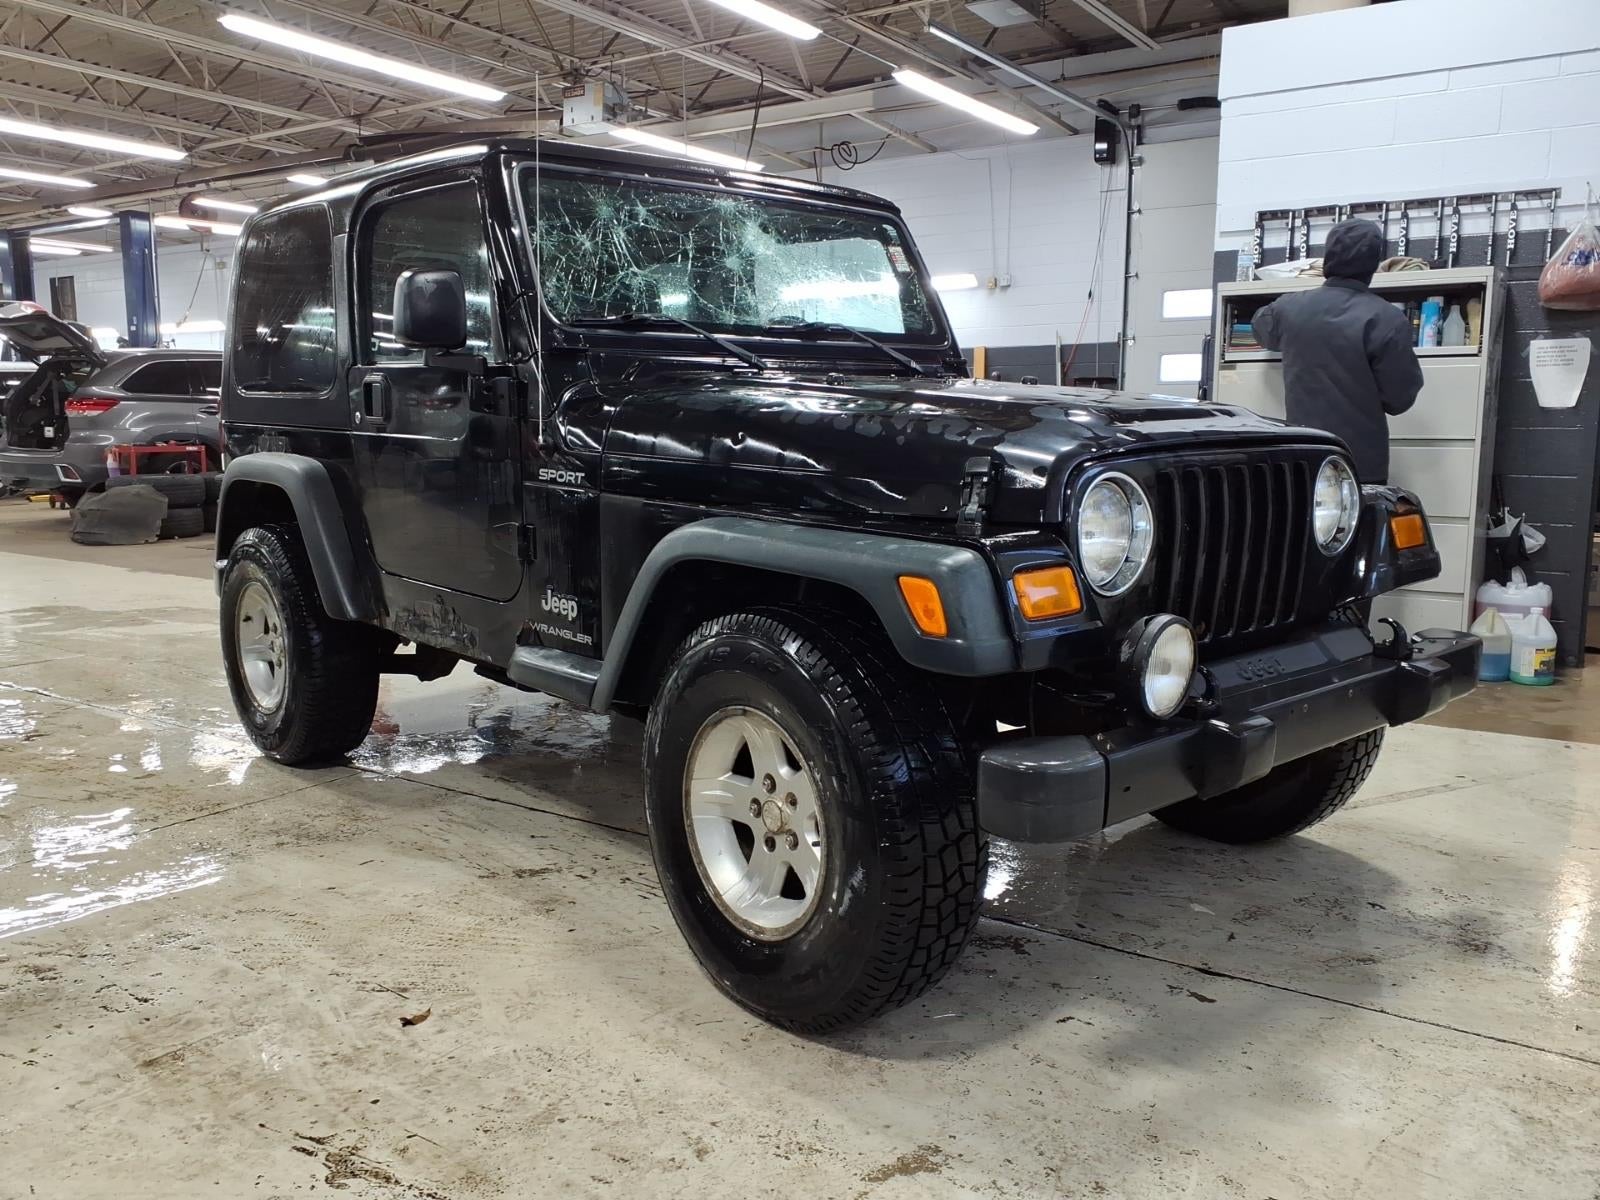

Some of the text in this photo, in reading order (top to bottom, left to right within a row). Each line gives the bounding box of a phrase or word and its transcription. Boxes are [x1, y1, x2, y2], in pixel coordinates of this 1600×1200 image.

[1449, 213, 1459, 252] HOVE
[1507, 210, 1517, 249] HOVE
[538, 468, 586, 484] SPORT
[541, 589, 578, 621] Jeep
[528, 620, 593, 645] WRANGLER
